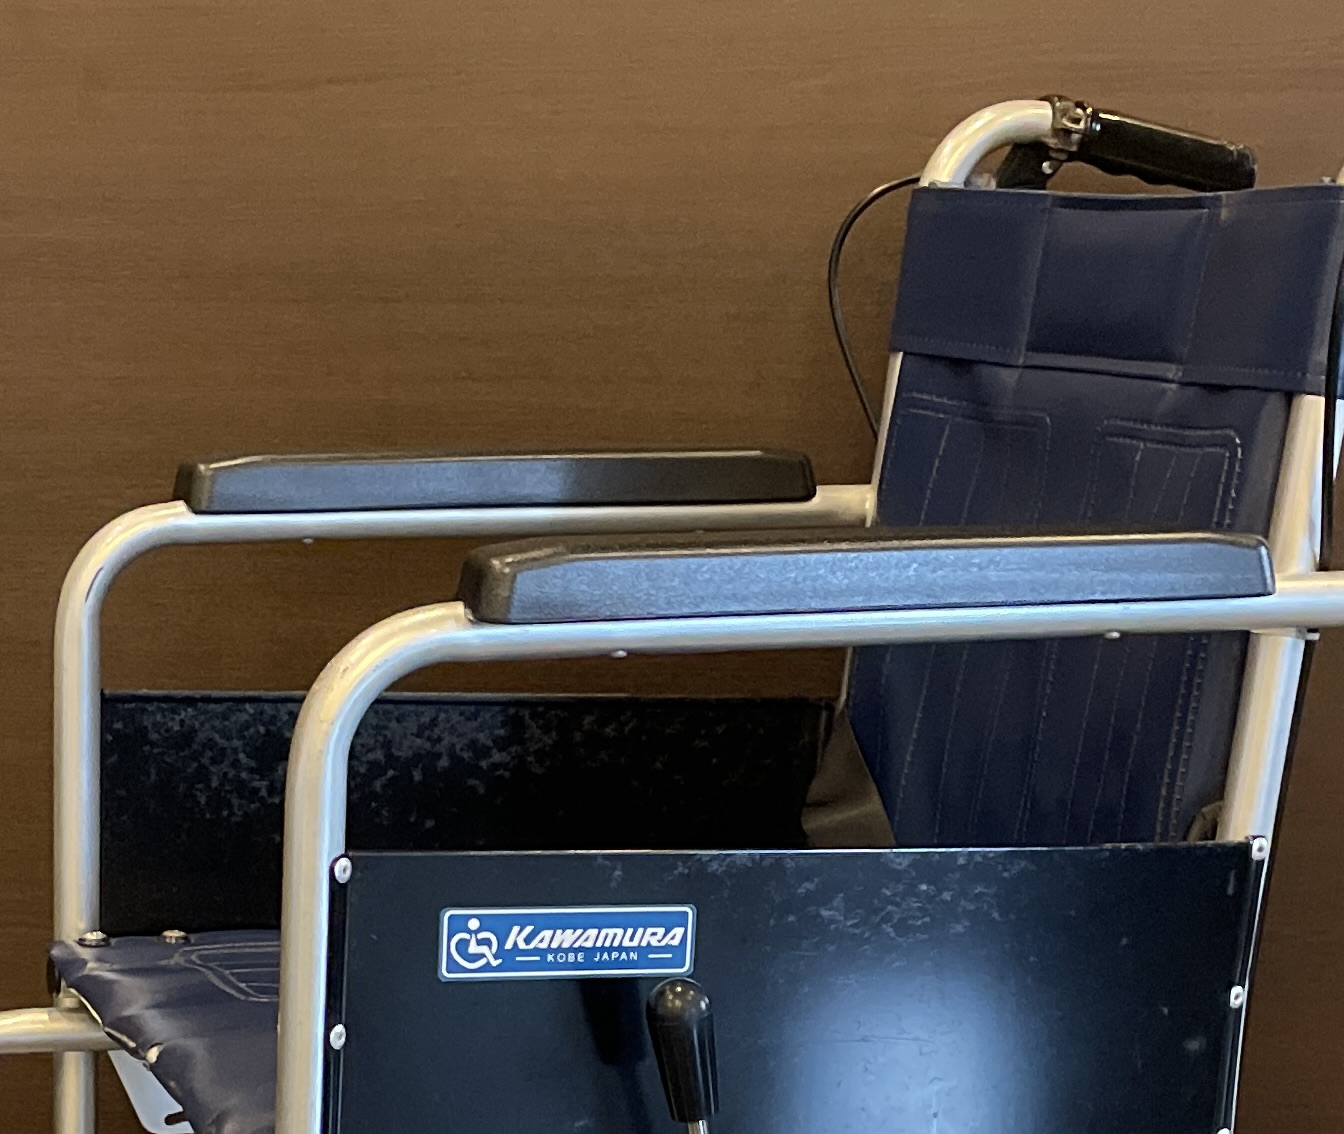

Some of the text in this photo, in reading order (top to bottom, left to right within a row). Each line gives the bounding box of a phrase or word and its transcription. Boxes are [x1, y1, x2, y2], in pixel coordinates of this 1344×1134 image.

[505, 925, 685, 949] KAWAMURA
[546, 951, 638, 963] KOBE JAPAN
